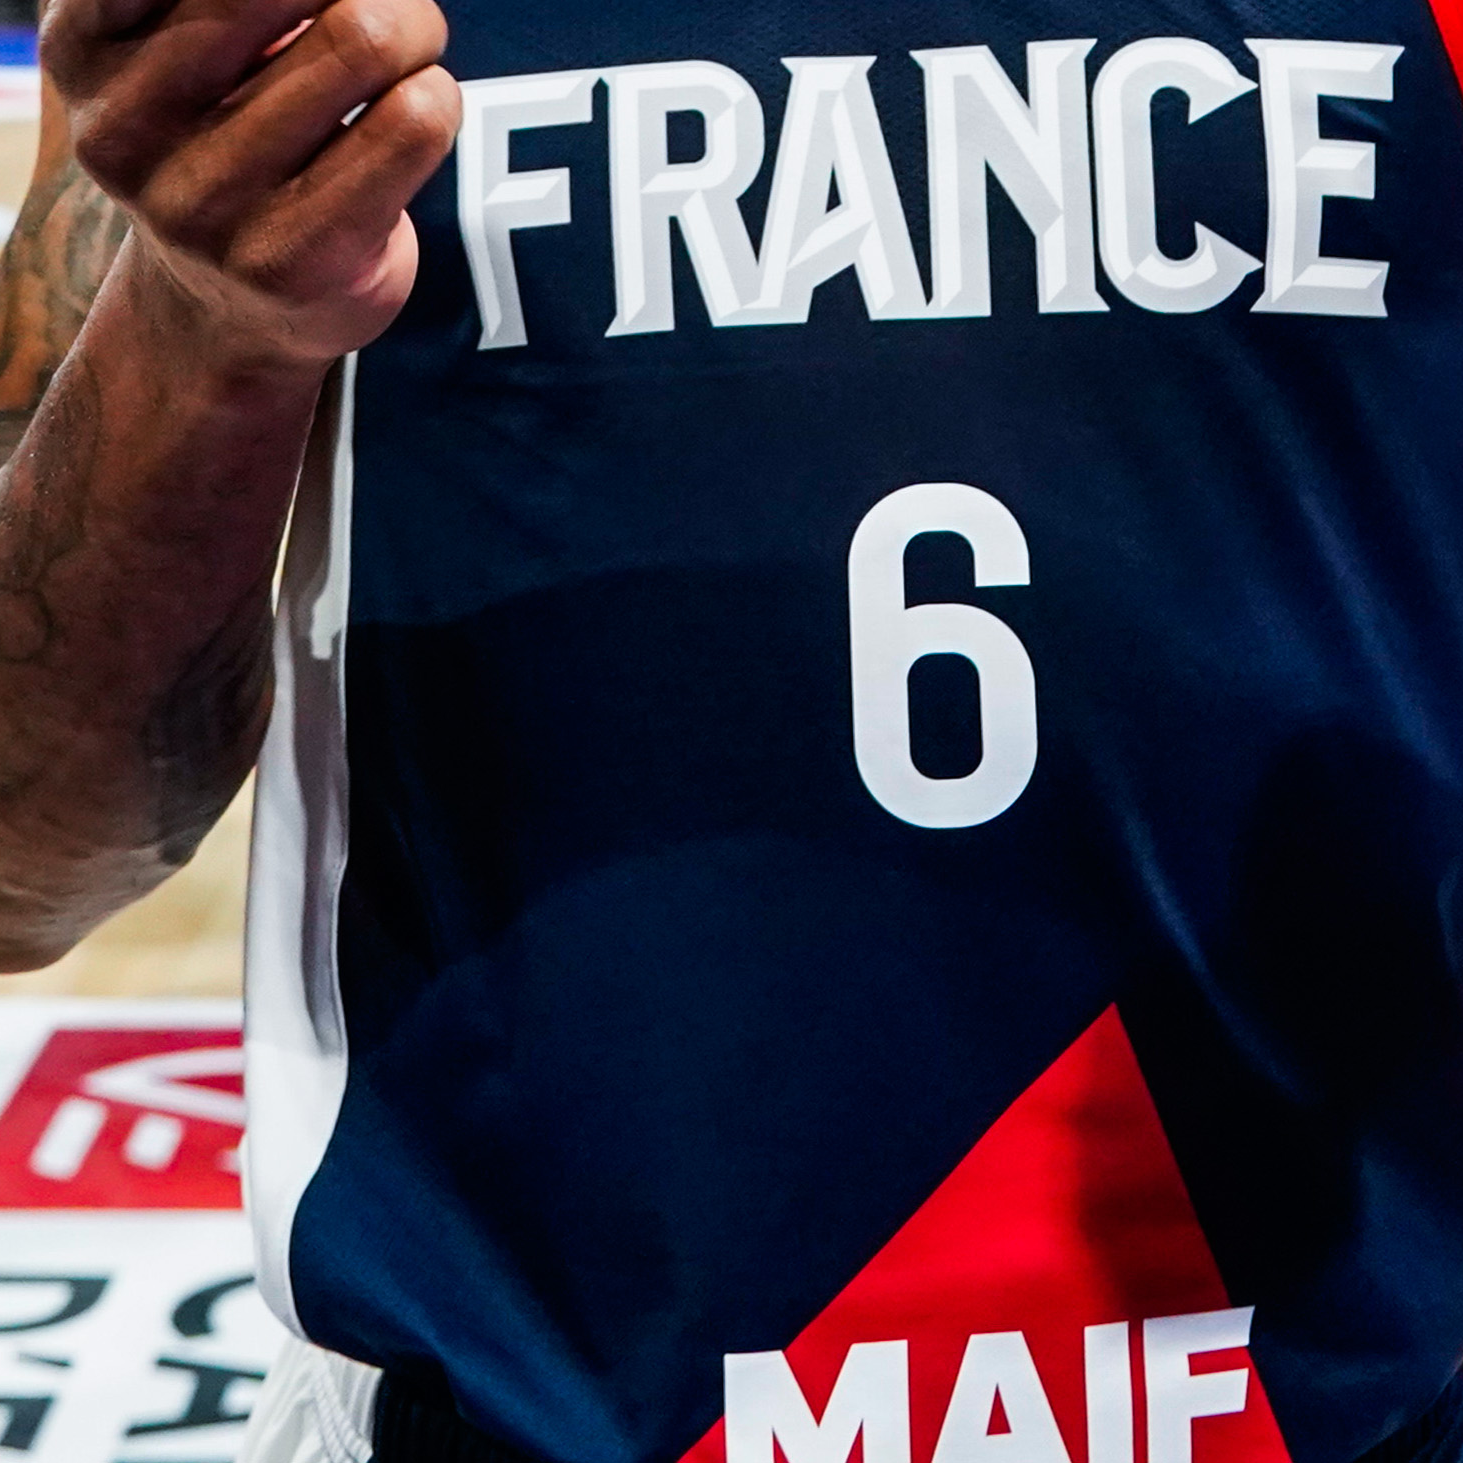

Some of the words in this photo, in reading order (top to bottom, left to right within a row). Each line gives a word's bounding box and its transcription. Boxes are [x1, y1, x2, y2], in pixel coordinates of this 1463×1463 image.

[457, 36, 1406, 351] FRANCE
[848, 482, 1039, 829] 6
[724, 1305, 1255, 1463] MAIF
